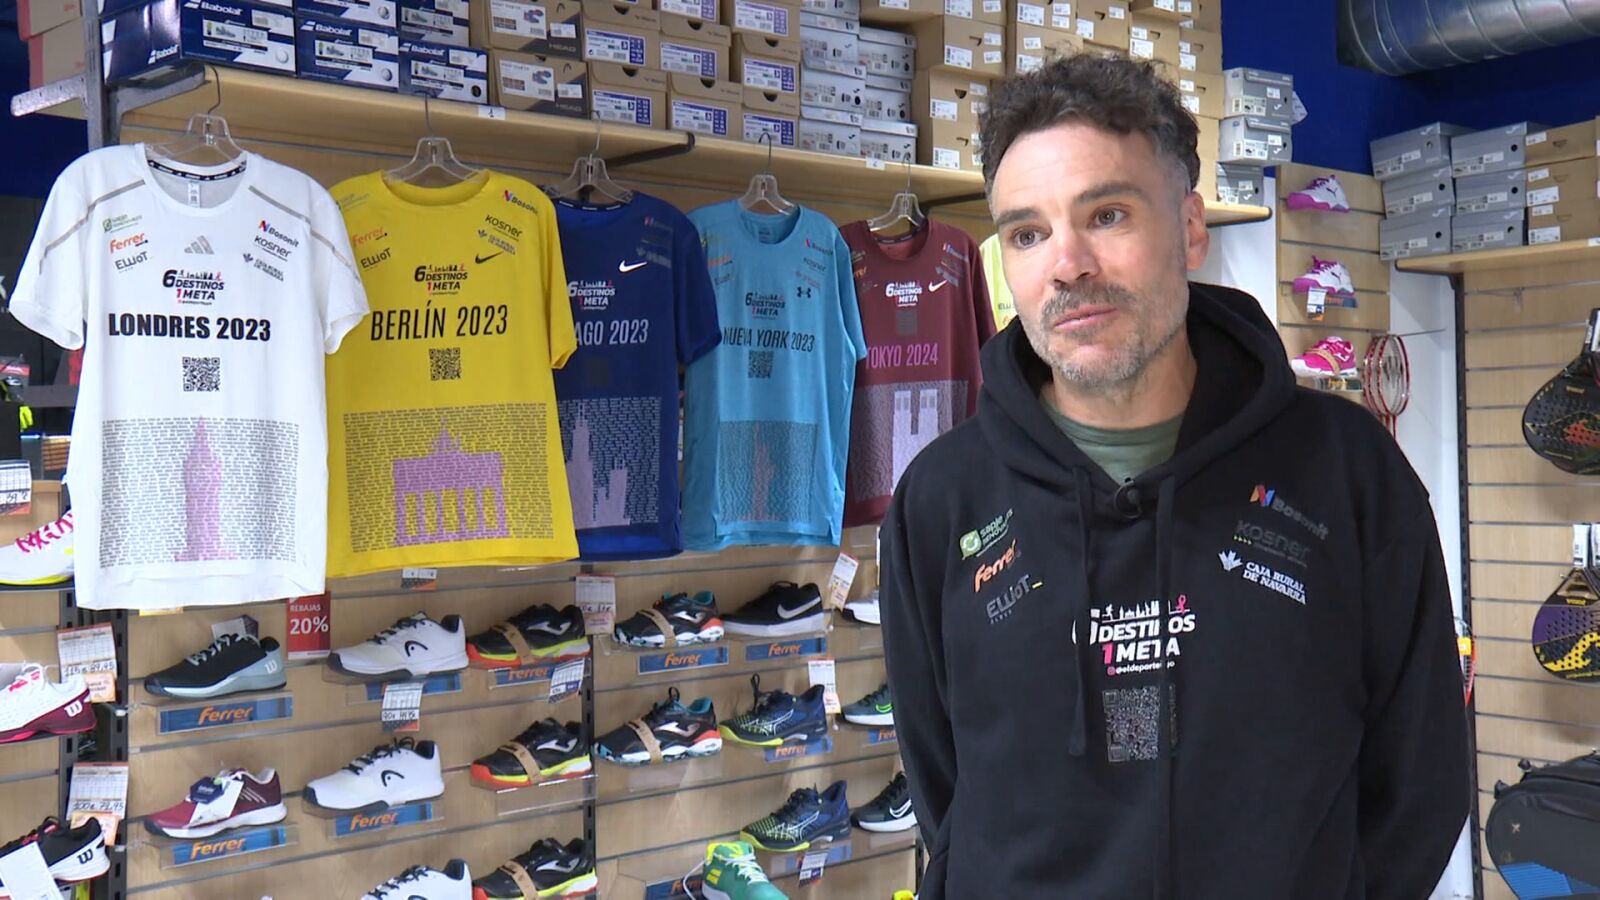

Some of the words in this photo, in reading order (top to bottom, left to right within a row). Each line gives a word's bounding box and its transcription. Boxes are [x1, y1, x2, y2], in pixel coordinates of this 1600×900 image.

[201, 2, 243, 16] Babolat
[315, 23, 353, 36] Babolat
[410, 44, 446, 57] Babolat
[268, 227, 299, 247] Bosonit
[162, 269, 178, 288] 6
[175, 279, 225, 291] DESTINOS
[414, 265, 427, 282] 6
[425, 271, 468, 282] DESTINOS
[176, 288, 182, 299] 1
[182, 289, 216, 300] META
[426, 281, 433, 291] 1
[433, 281, 461, 291] META
[567, 281, 579, 297] 6
[577, 287, 616, 297] DESTINOS
[885, 283, 896, 297] 6
[893, 287, 923, 296] DESTINOS
[583, 296, 609, 305] META
[745, 292, 753, 306] 6
[898, 294, 919, 303] META
[370, 300, 447, 341] BERLÍN
[456, 304, 509, 337] 2023
[756, 307, 779, 316] META
[108, 312, 210, 339] LONDRES
[216, 317, 271, 342] 2023
[608, 318, 649, 345] 2023
[723, 327, 752, 347] NUEVA
[755, 328, 789, 349] YORK
[790, 332, 816, 353] 2023
[866, 345, 902, 369] TOKYO
[906, 343, 939, 367] 2024
[1272, 496, 1329, 541] Bosonit
[1246, 561, 1272, 579] CAJA
[1272, 570, 1306, 594] RURAL
[1242, 569, 1259, 583] DE
[1260, 576, 1307, 605] NAVARRA
[289, 603, 321, 612] REBAJAS
[290, 615, 329, 636] 20%
[768, 643, 802, 657] Ferrer
[1102, 642, 1114, 665] 1
[1115, 636, 1181, 663] META
[664, 652, 702, 668] Ferrer
[198, 705, 253, 725] Ferrer
[350, 811, 399, 832] Ferrer
[191, 836, 246, 859] Ferrer
